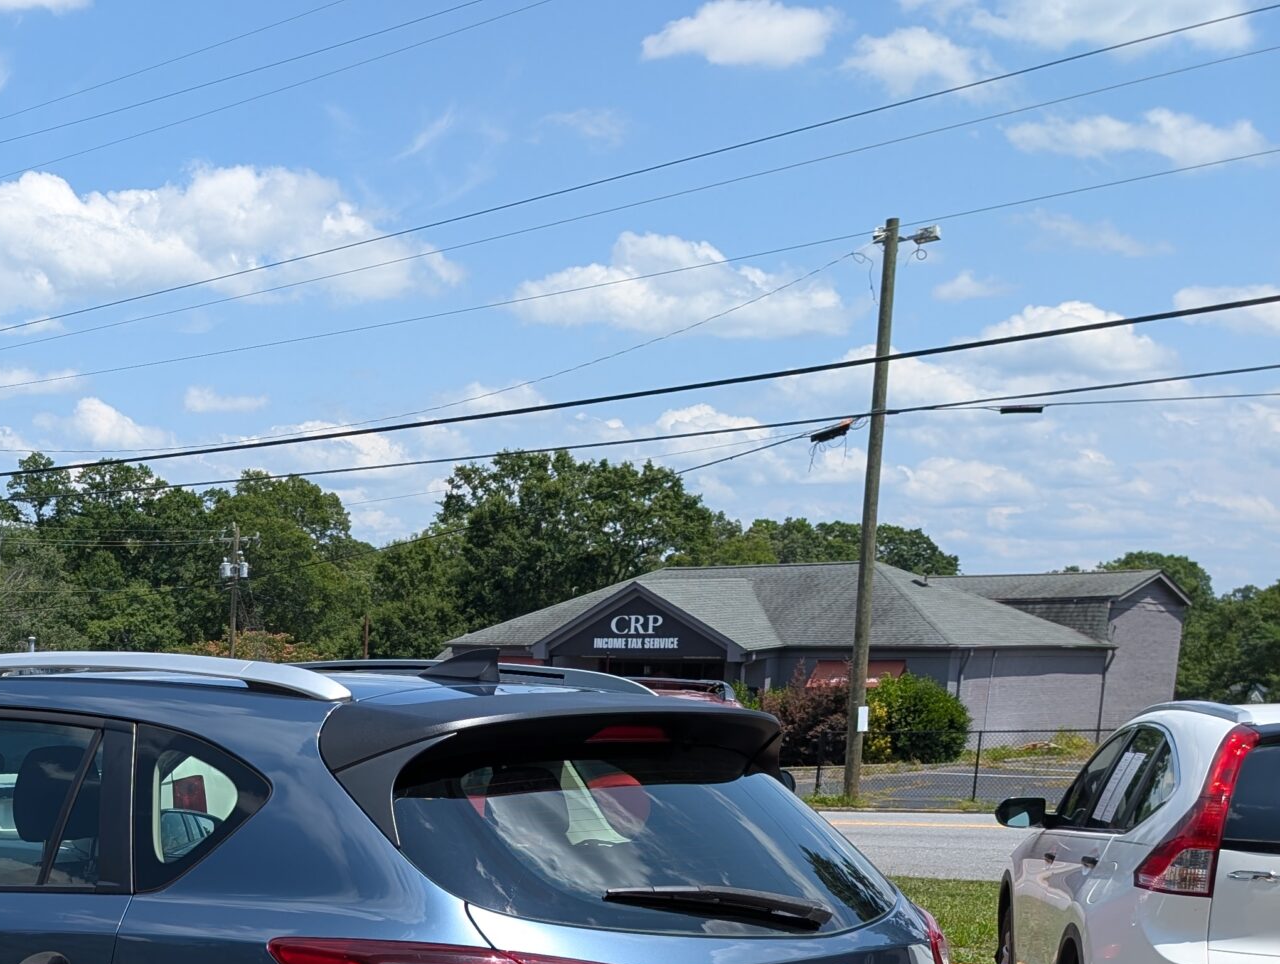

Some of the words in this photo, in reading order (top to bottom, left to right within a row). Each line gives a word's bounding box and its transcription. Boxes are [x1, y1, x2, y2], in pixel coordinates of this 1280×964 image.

[610, 614, 664, 635] CRP
[593, 637, 626, 649] INCOME
[627, 637, 643, 649] TAX
[643, 637, 679, 649] SERVICE
